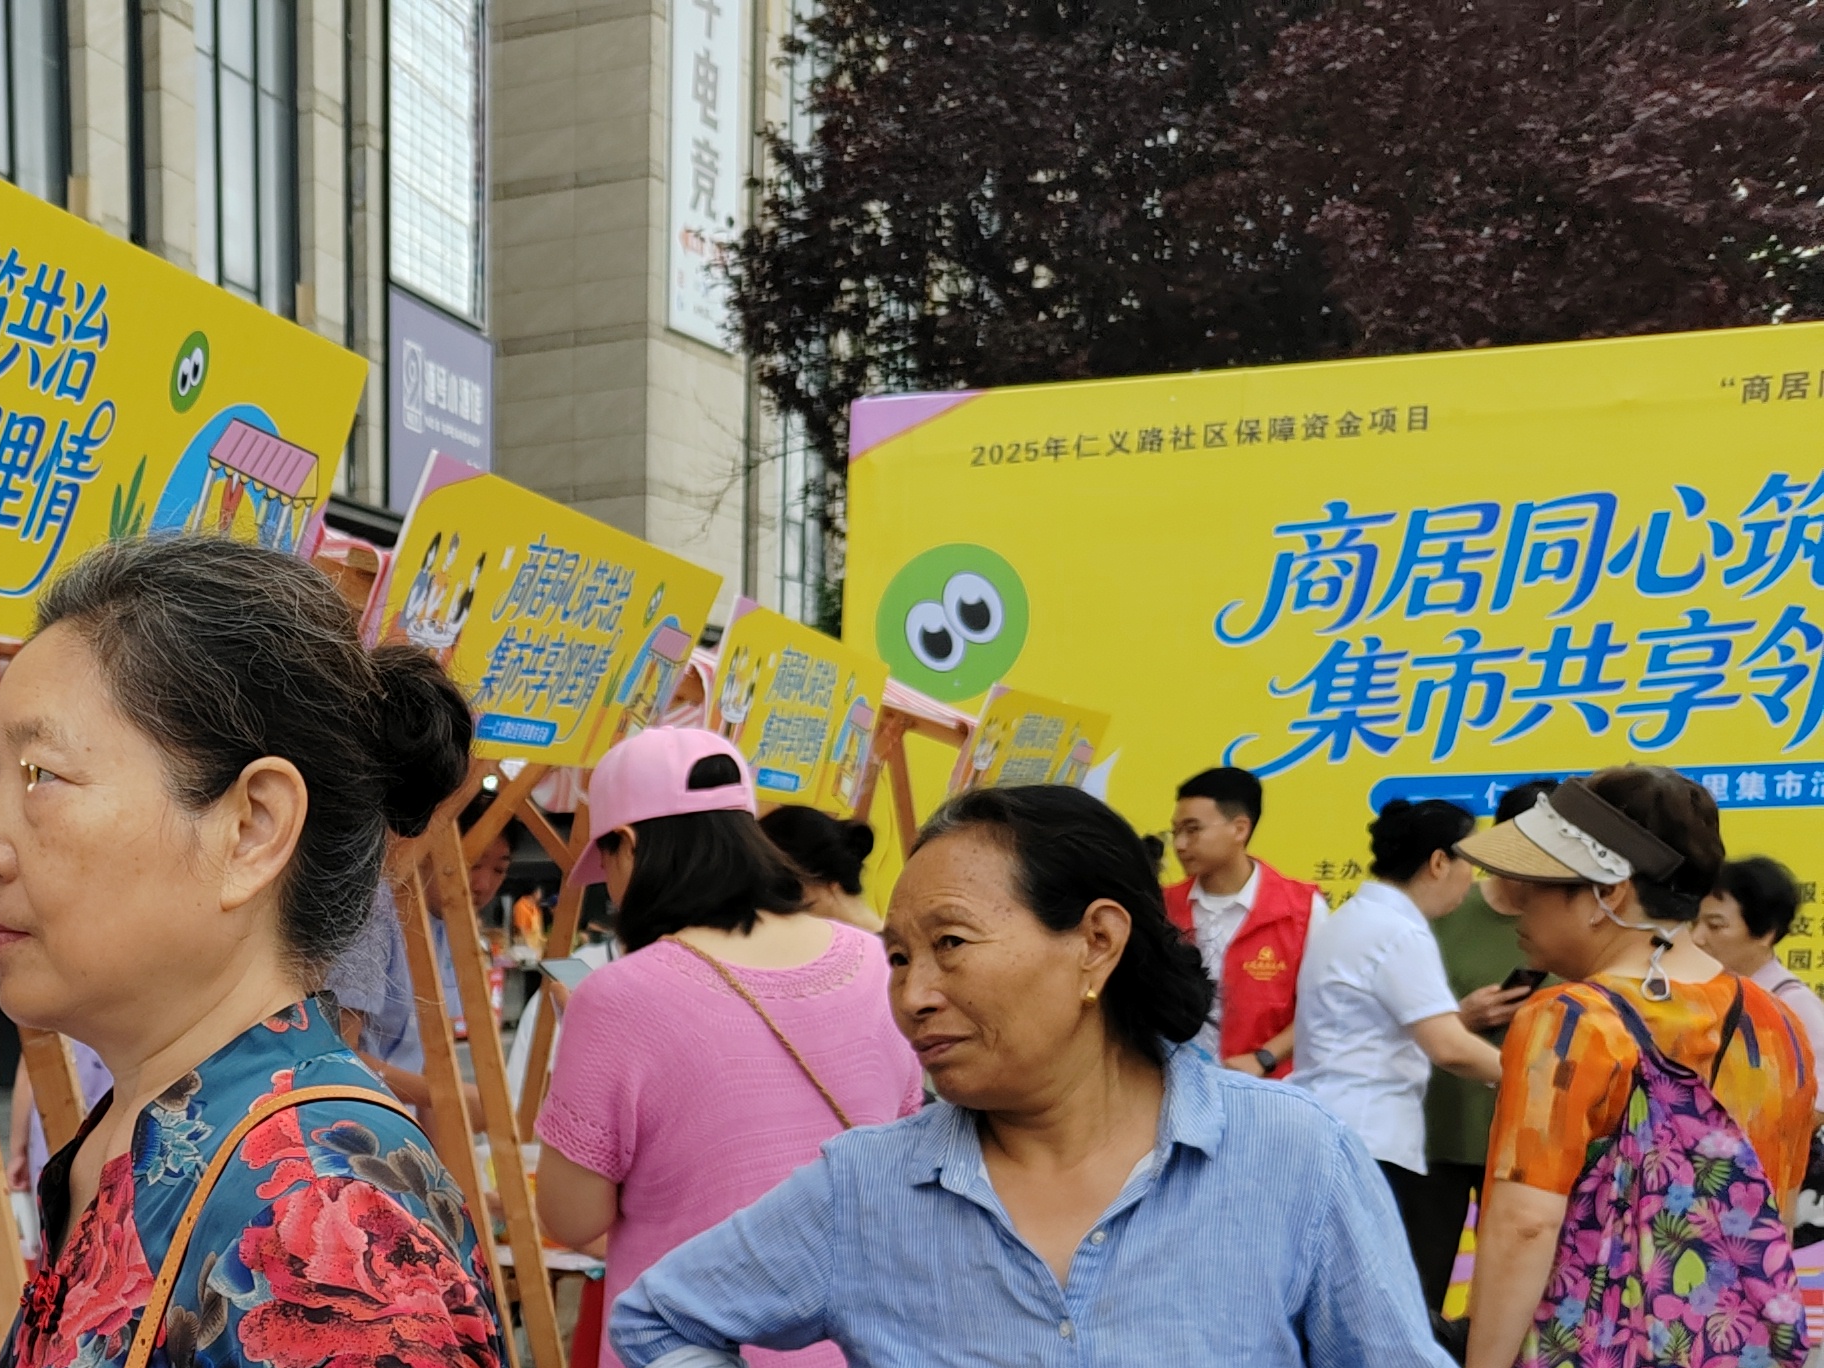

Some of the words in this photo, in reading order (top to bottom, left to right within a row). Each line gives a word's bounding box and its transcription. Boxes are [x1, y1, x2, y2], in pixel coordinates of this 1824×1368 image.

[1720, 371, 1824, 404] “商居
[971, 406, 1431, 468] 2025年仁义路社区保障资金项目
